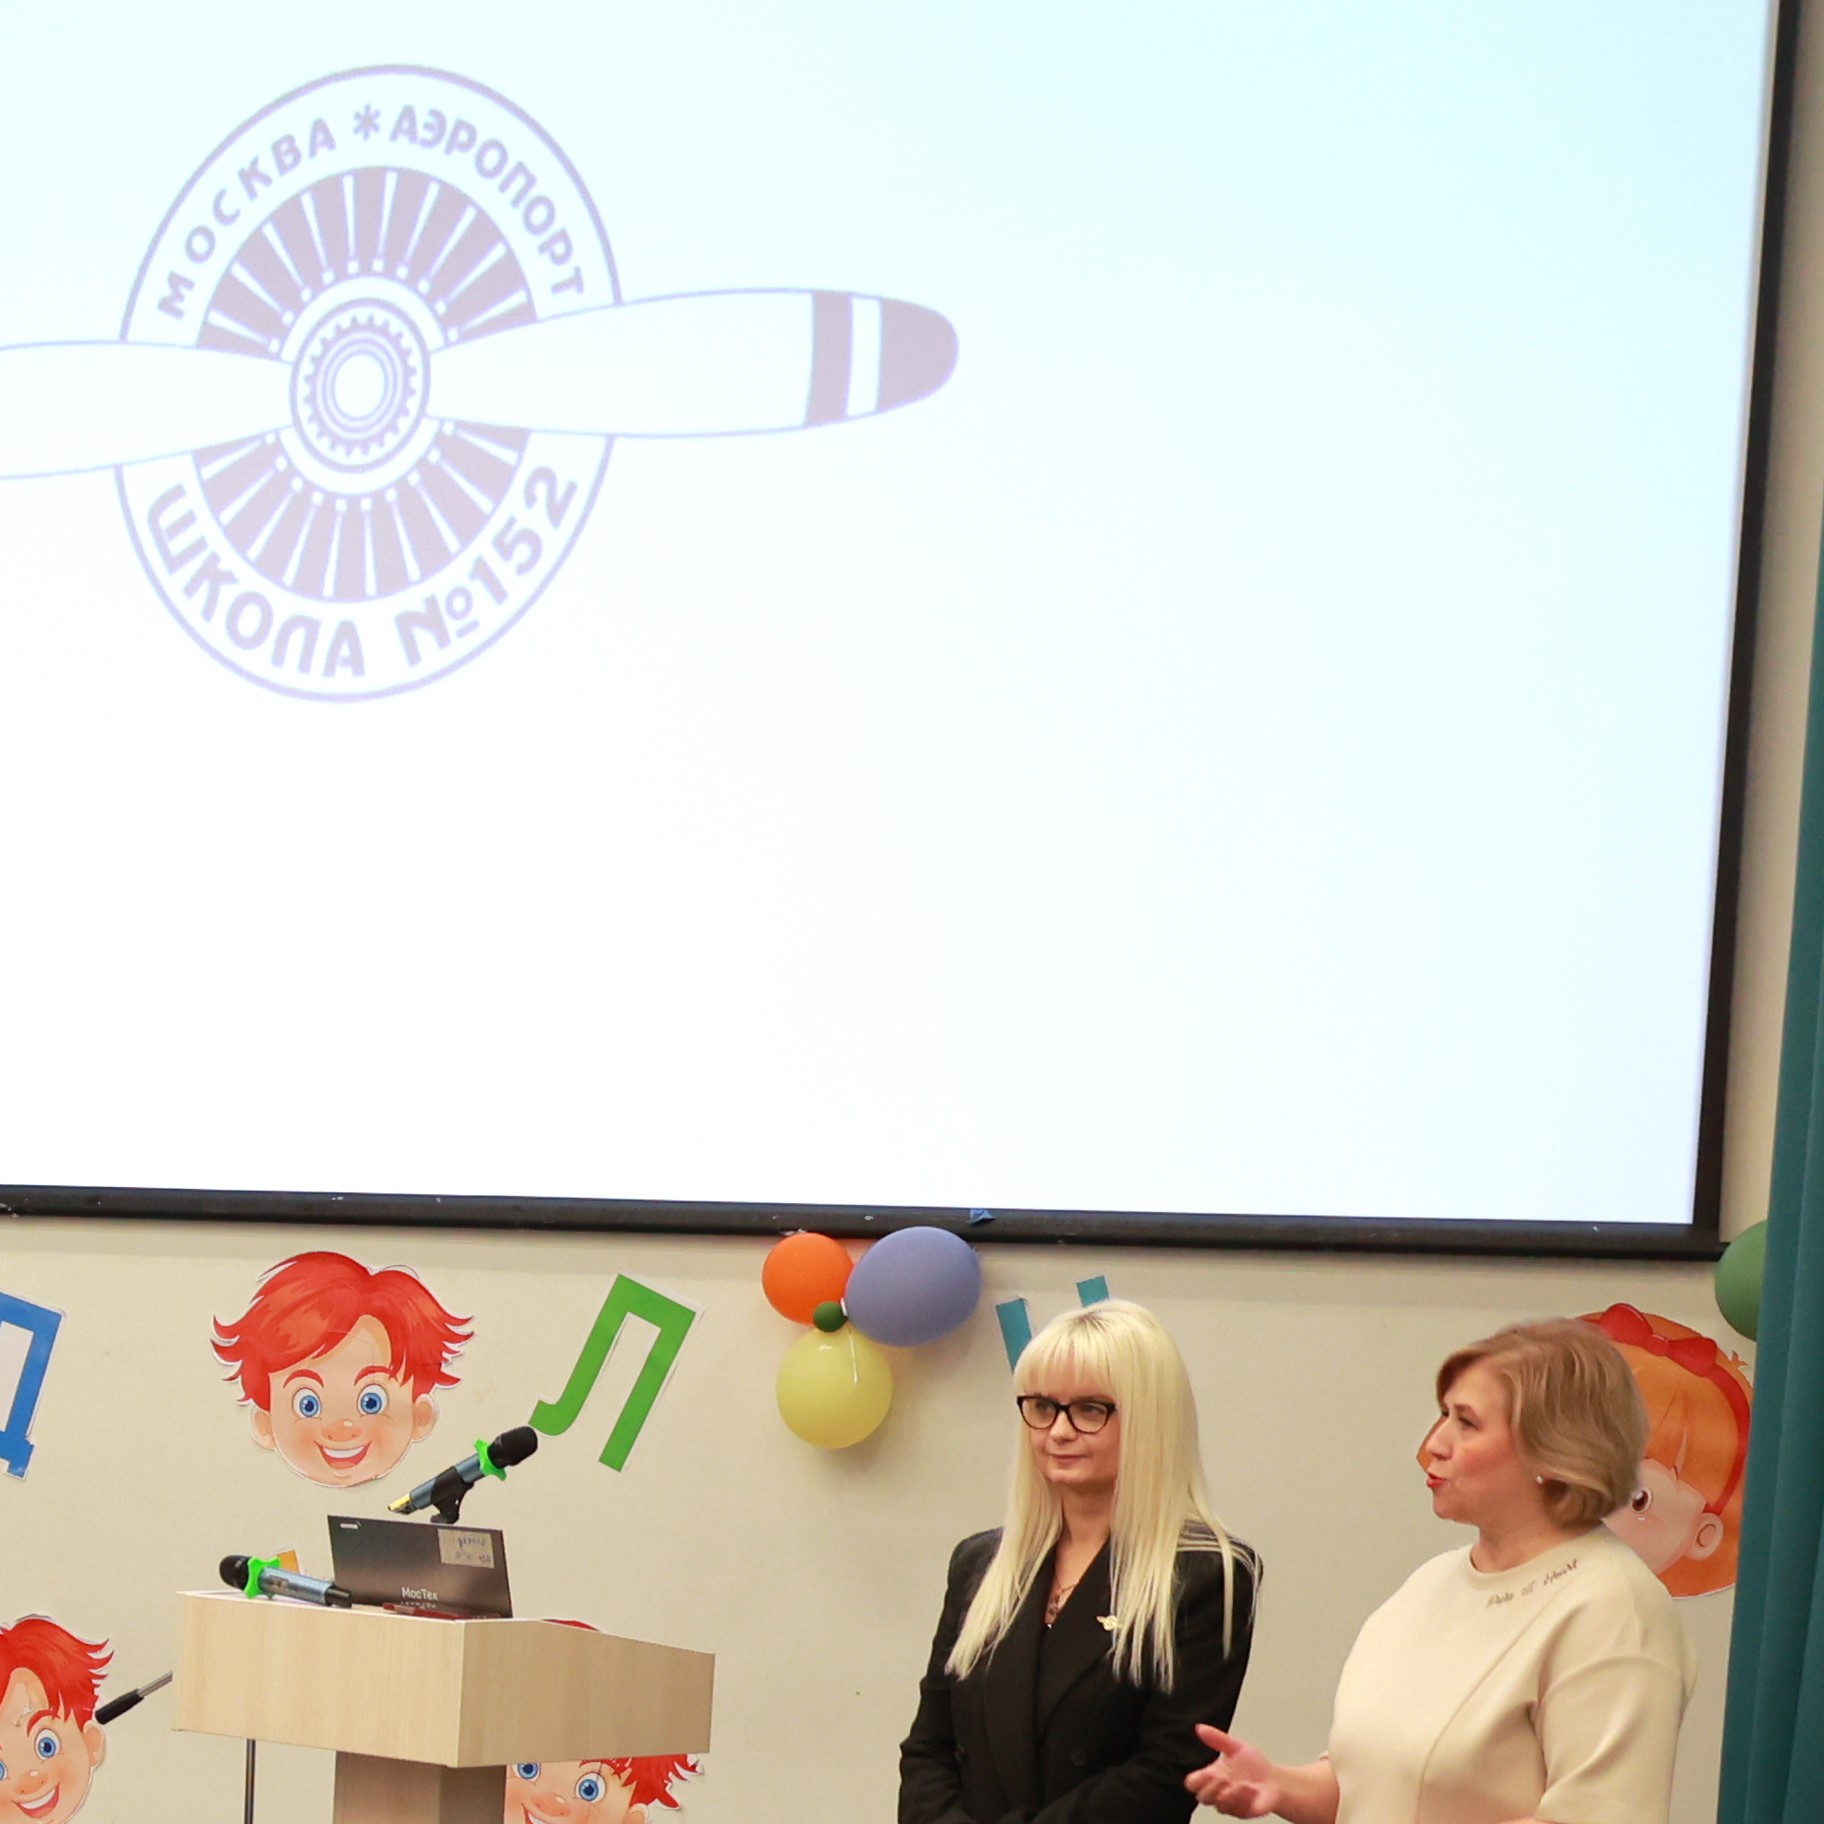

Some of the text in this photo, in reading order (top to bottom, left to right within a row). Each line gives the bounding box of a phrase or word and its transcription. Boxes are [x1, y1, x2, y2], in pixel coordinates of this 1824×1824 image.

[156, 103, 586, 321] МОСКВА АЭРОПОРТ
[146, 465, 579, 679] ШКОЛА №152
[527, 1273, 696, 1474] Л
